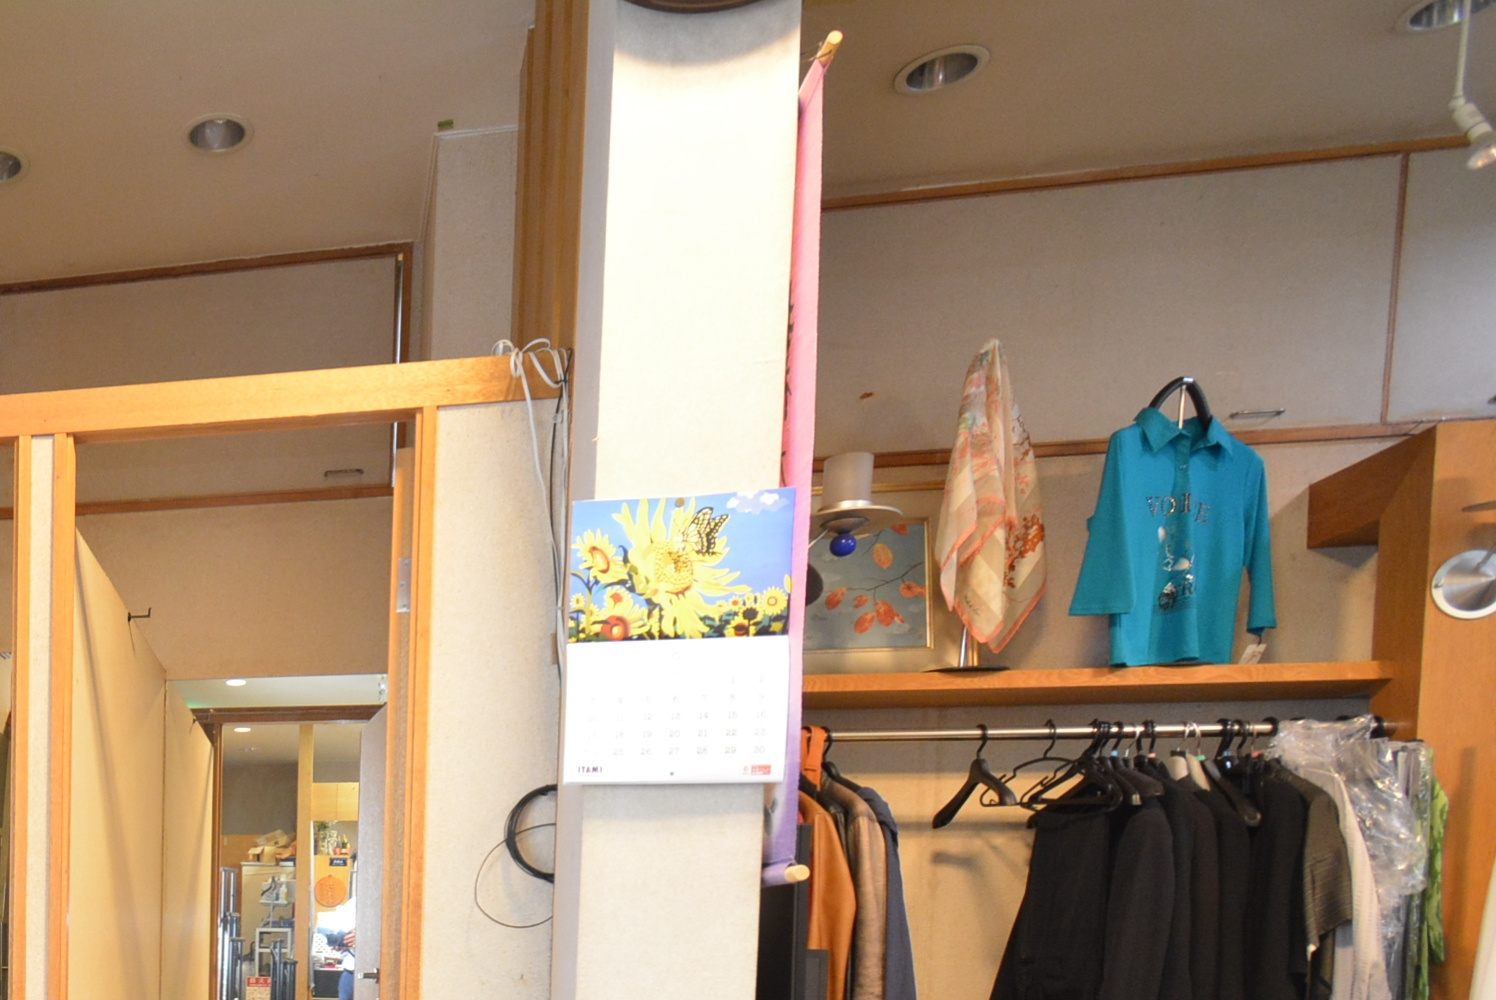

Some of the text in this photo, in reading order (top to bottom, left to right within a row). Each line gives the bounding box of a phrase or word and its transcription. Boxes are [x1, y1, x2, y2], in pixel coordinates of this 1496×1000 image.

[671, 712, 681, 720] 13
[728, 711, 738, 719] 15
[756, 710, 766, 718] 16
[642, 730, 652, 738] 19
[669, 730, 680, 738] 20
[697, 729, 708, 737] 21
[725, 728, 737, 736] 22
[754, 728, 766, 736] 23
[613, 746, 765, 756] 25 26 27 28 29 30
[577, 765, 603, 773] ITAMI
